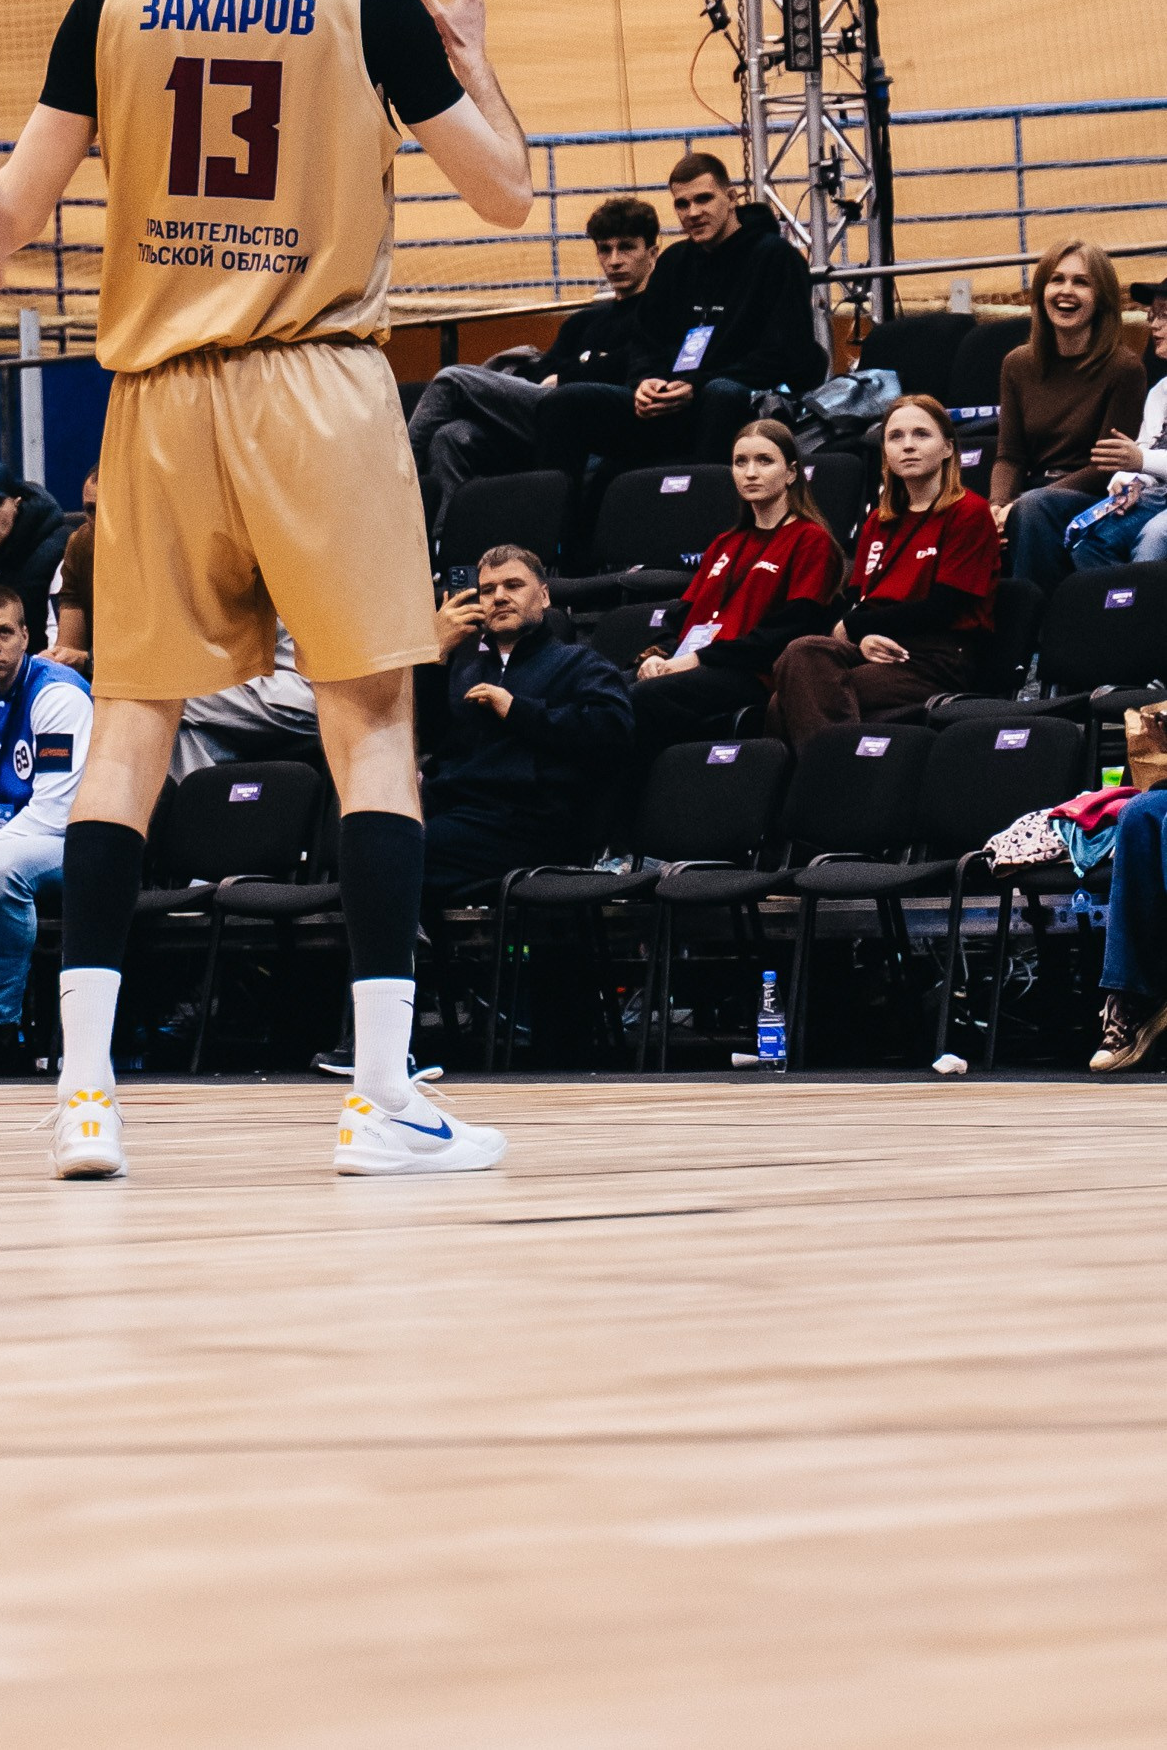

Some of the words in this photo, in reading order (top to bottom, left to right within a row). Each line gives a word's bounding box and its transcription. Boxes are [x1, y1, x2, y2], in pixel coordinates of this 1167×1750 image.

[164, 56, 283, 201] 13
[221, 250, 310, 274] ОБЛАСТИ
[15, 746, 30, 772] 69
